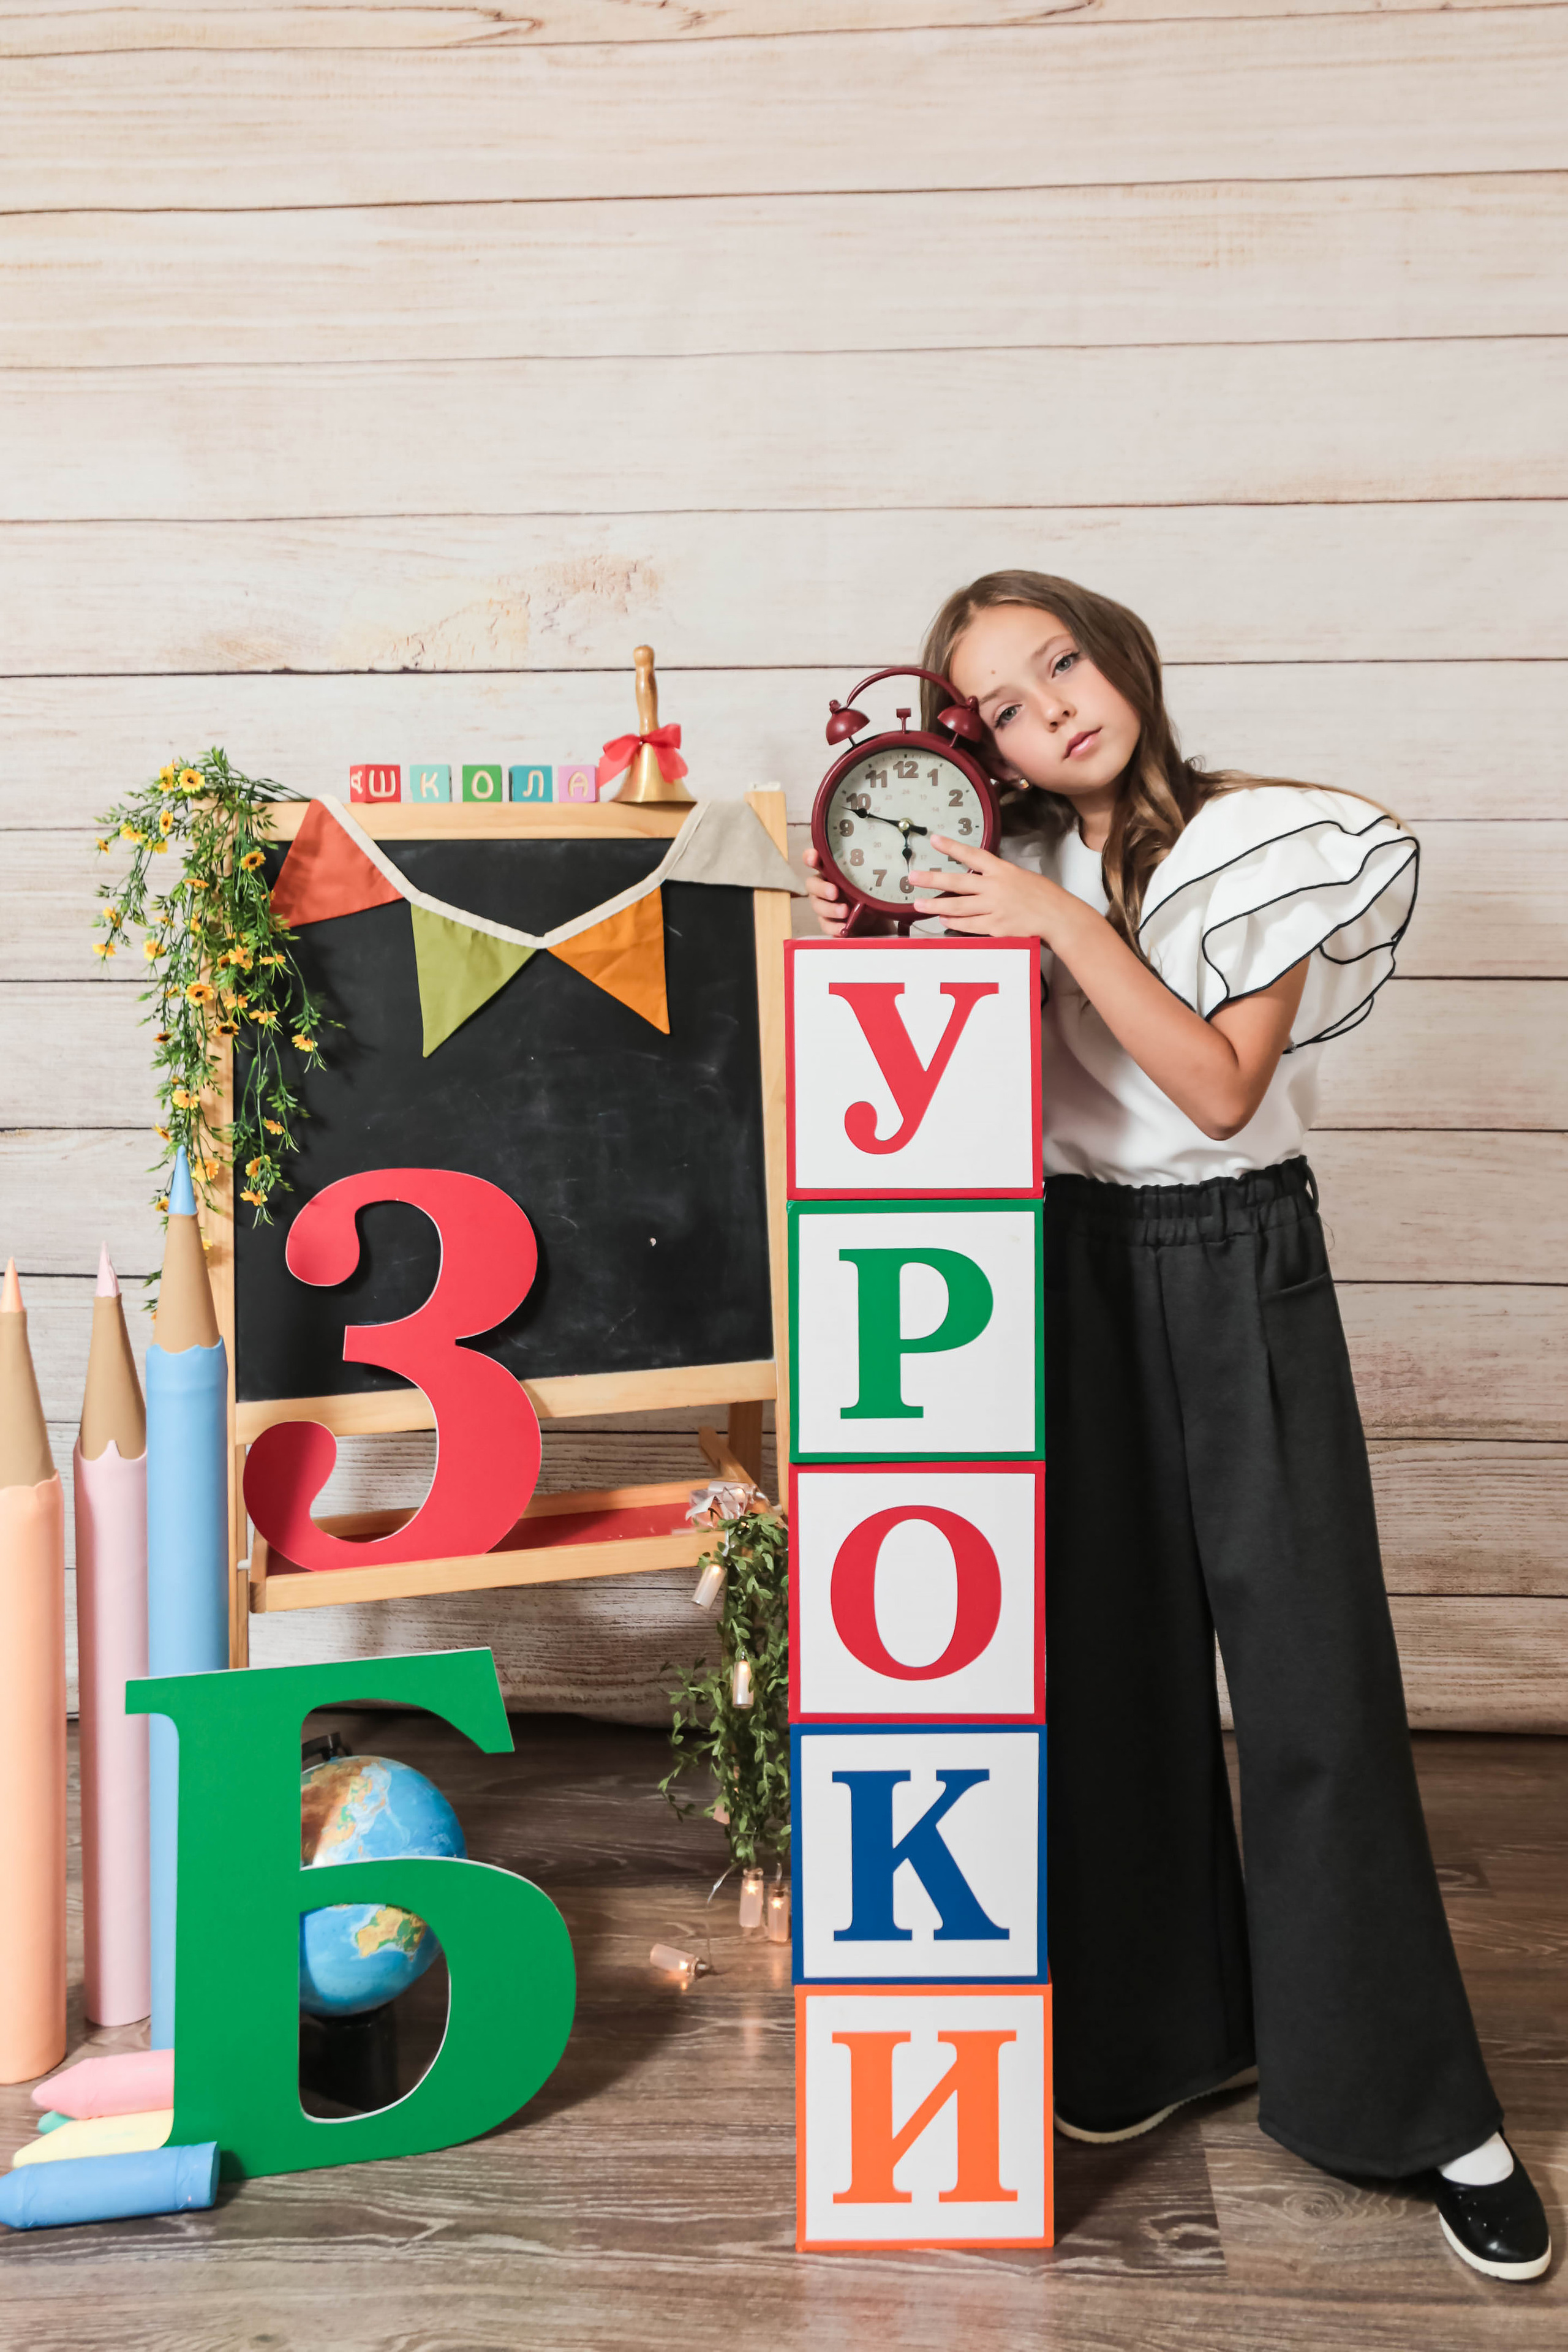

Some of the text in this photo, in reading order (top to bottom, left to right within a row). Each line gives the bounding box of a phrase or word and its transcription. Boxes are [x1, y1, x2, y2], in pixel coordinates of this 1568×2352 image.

[893, 761, 919, 778] 12
[927, 769, 938, 786] 1
[369, 769, 589, 799] ШКОЛА
[865, 769, 888, 788] 11
[846, 793, 872, 810] 10
[949, 790, 963, 807] 2
[839, 819, 854, 837] 9
[958, 818, 973, 835] 3
[850, 848, 865, 866] 8
[873, 870, 887, 886] 7
[900, 876, 914, 894] 6
[126, 1647, 576, 2177] Б
